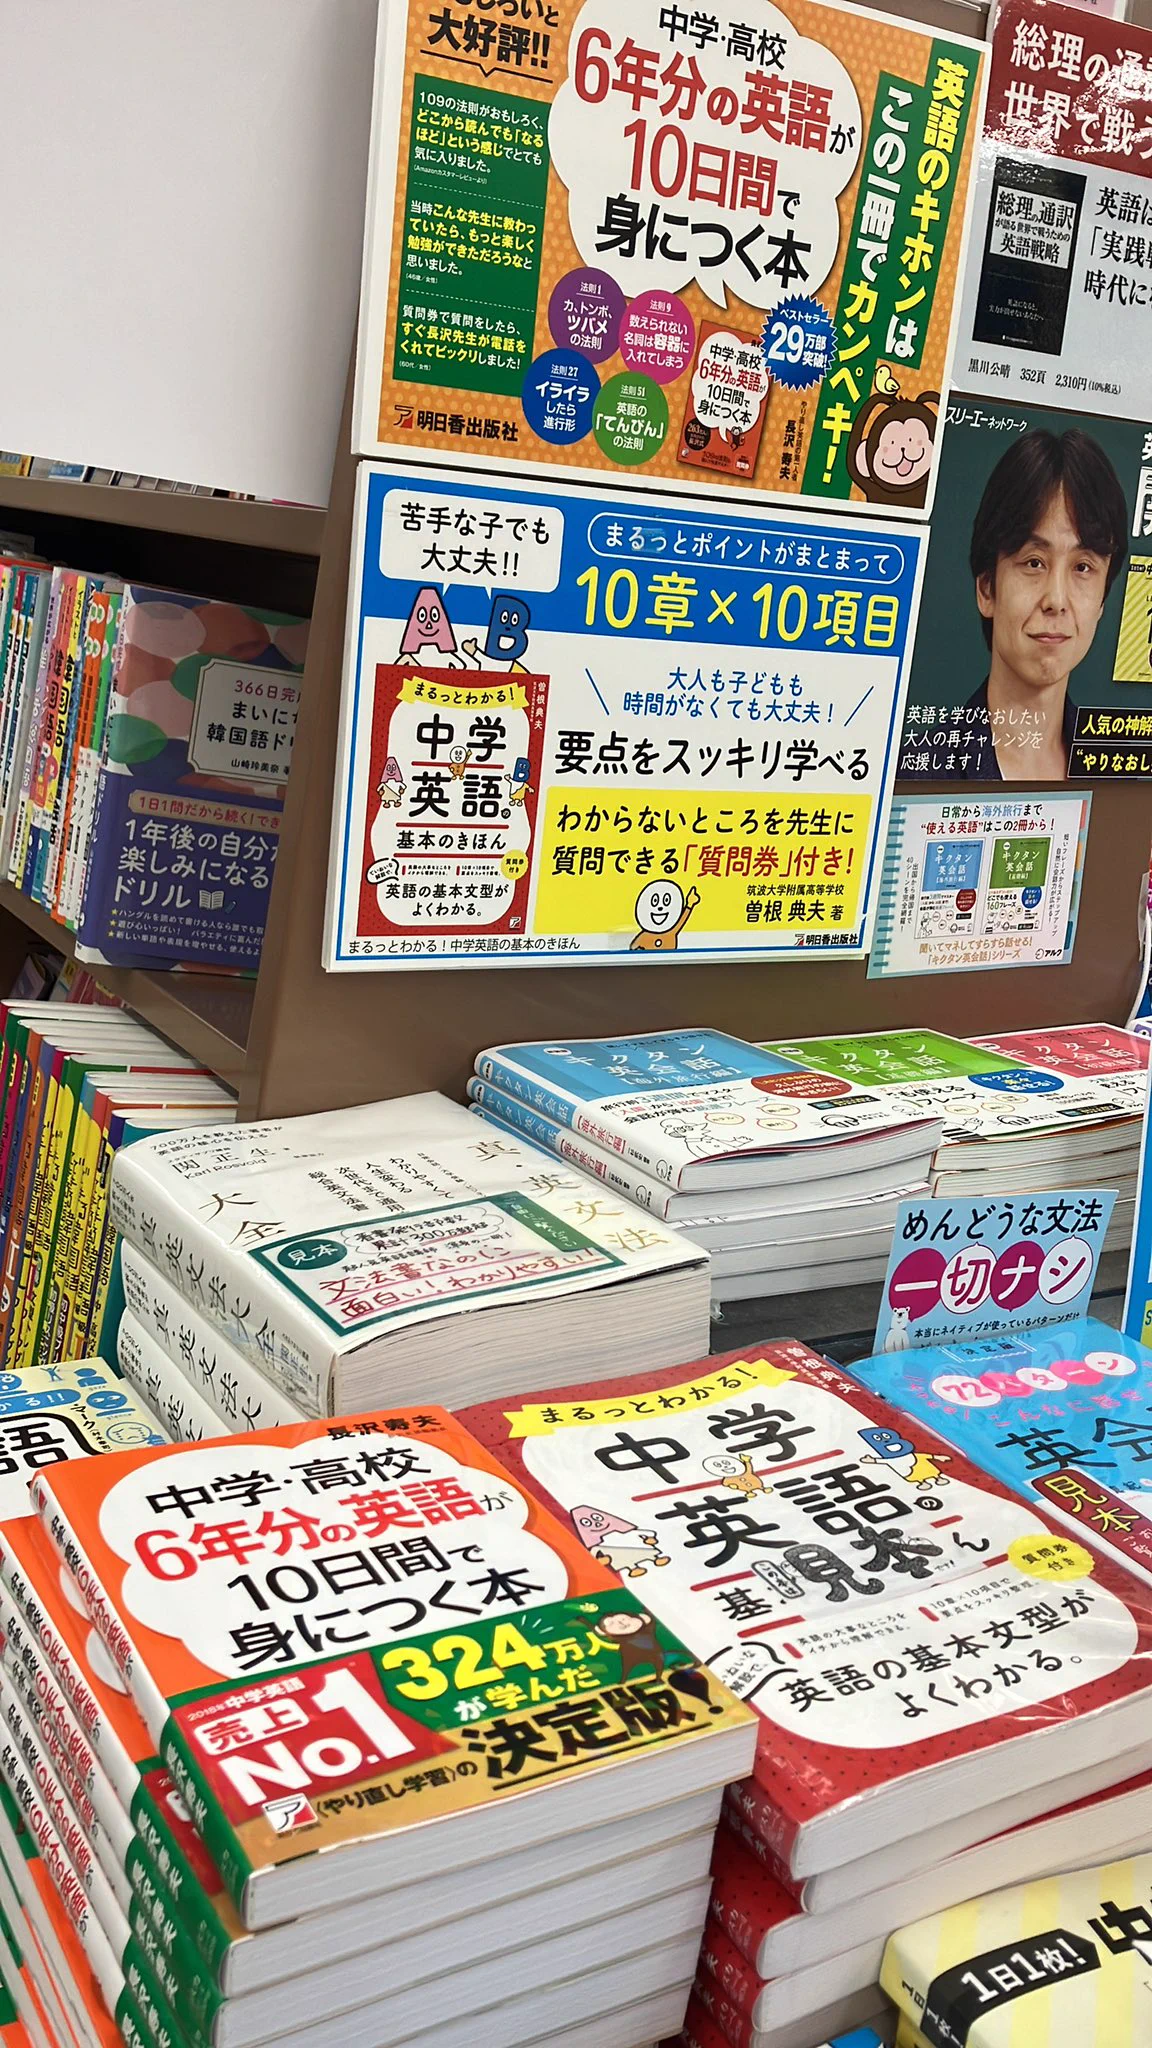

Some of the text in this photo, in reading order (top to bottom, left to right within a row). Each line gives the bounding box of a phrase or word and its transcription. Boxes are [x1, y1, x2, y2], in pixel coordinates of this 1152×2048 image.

[427, 7, 550, 69] 大好評!!
[659, 4, 787, 70] 中学・高校
[574, 27, 856, 155] 6年分の英語が
[416, 107, 544, 148] どこから読んでも「なる
[419, 91, 544, 131] 109の法則がおもしろく、
[414, 146, 491, 174] 気に入りました。
[415, 126, 542, 166] ほど」という感じでとても
[623, 118, 800, 220] 10日間で
[410, 200, 536, 234] 当時こんな先生に教わっ
[885, 57, 969, 358] 英語のキホンは
[996, 190, 1076, 230] 総理の通訳
[409, 217, 535, 253] ていたら、もっと楽しく
[595, 192, 811, 289] 身につく本
[1000, 232, 1060, 264] 英語戦略
[1090, 226, 1152, 270] 「実践
[406, 254, 463, 276] 思いました。
[407, 234, 533, 270] 勉強ができただろうなと
[822, 86, 914, 484] この一冊でカンペキ!
[1084, 270, 1152, 309] 時代に
[402, 304, 521, 335] 質問券で質問をしたら、
[567, 315, 608, 335] ツバメ
[629, 314, 688, 336] 数えられない
[779, 307, 829, 326] ベストセラー
[401, 321, 527, 354] すぐ長沢先生が電話を
[570, 334, 602, 350] の法則
[623, 331, 690, 354] 名詞は容器に
[767, 321, 828, 369] 29 万部 突破!
[399, 339, 521, 370] くれてビックリしました!
[625, 350, 684, 370] 入れてしまう
[709, 342, 762, 371] 中学・高校
[968, 358, 1047, 384] 黒川公晴 352頁
[535, 381, 590, 403] イライラ
[699, 357, 766, 394] 6年分の英語が
[546, 402, 577, 416] したら
[616, 402, 647, 417] 英語の
[697, 399, 753, 426] 身につく本
[707, 384, 751, 408] 10日間で
[416, 411, 518, 441] 明日香出版社
[543, 416, 576, 432] 進行形
[595, 413, 665, 439] 「てんびん」
[944, 406, 1028, 432] スリーエーネットワーク
[613, 436, 644, 451] の法則
[400, 502, 549, 545] 苦手な子でも
[420, 542, 519, 577] 大丈夫!!
[605, 521, 891, 576] まるっとポイントがまとまって
[576, 565, 900, 649] 10章×10項目
[234, 680, 300, 703] 366日完
[414, 681, 515, 706] まるっとわかる!
[667, 666, 803, 696] 大人も子どもも
[622, 691, 834, 725] 時間がなくても大丈夫!
[906, 704, 1047, 726] 英語を学びなおしたい
[416, 713, 507, 762] 中学
[903, 729, 1044, 749] 大人の再チャレンジを
[555, 729, 870, 783] 要点をスッキリ学べる
[900, 752, 981, 771] 応援します!
[408, 771, 511, 819] 英語の
[941, 804, 1043, 819] 日常から海外旅行まで
[556, 803, 855, 836] わからないところを先生に
[396, 830, 507, 851] 基本のきほん
[1002, 851, 1040, 861] キクタン
[118, 846, 270, 889] 楽しみになる
[551, 843, 853, 878] 質問できる「質問券」付き!
[935, 853, 972, 864] キクタン
[938, 864, 966, 876] 英会話
[1005, 862, 1033, 873] 英会話
[113, 875, 192, 909] ドリル
[385, 883, 509, 899] 英語の基本文型が
[746, 884, 844, 896] 筑波大学附属高等学校
[412, 902, 482, 917] よくわかる。
[745, 899, 844, 924] 曽根 典夫 著
[348, 936, 581, 954] まるっとわかる!中学英語の基本のきほん
[805, 933, 859, 946] 明日香出版社
[918, 936, 1033, 954] 聞いてマネしてすらすら話せる!
[1044, 948, 1063, 958] アルク
[927, 949, 1022, 965] 「キクタン英会話」シリーズ
[902, 1197, 1103, 1243] めんどうな文法
[288, 1241, 340, 1267] 見本
[320, 1246, 512, 1301] 文法書なのに
[894, 1255, 1087, 1307] 一切ナシ
[913, 1312, 1081, 1339] 本当にネイティブが使っているパターンだけ
[540, 1365, 761, 1425] まるっとわかる!
[942, 1357, 1119, 1401] 72パターン
[594, 1402, 816, 1486] 中学
[145, 1446, 431, 1520] 中学・高校
[1043, 1474, 1140, 1533] 見本
[134, 1475, 512, 1581] 6年分の英語が
[1021, 1544, 1069, 1565] 質問券
[1047, 1557, 1075, 1572] 付き
[227, 1535, 485, 1611] 10日間で
[227, 1567, 546, 1670] 身につく本
[797, 1611, 908, 1646] 英語の大事なところを
[778, 1587, 1096, 1713] 英語の基本文型が
[808, 1624, 912, 1655] イチから理解できる。
[382, 1622, 620, 1701] 324万人
[454, 1667, 601, 1722] が学んだ
[895, 1647, 1084, 1718] よくわかる。
[202, 1704, 302, 1751] 売上
[218, 1667, 416, 1806] No.1
[461, 1664, 725, 1780] 決定版!
[961, 1937, 1088, 2003] 1日1枚!
